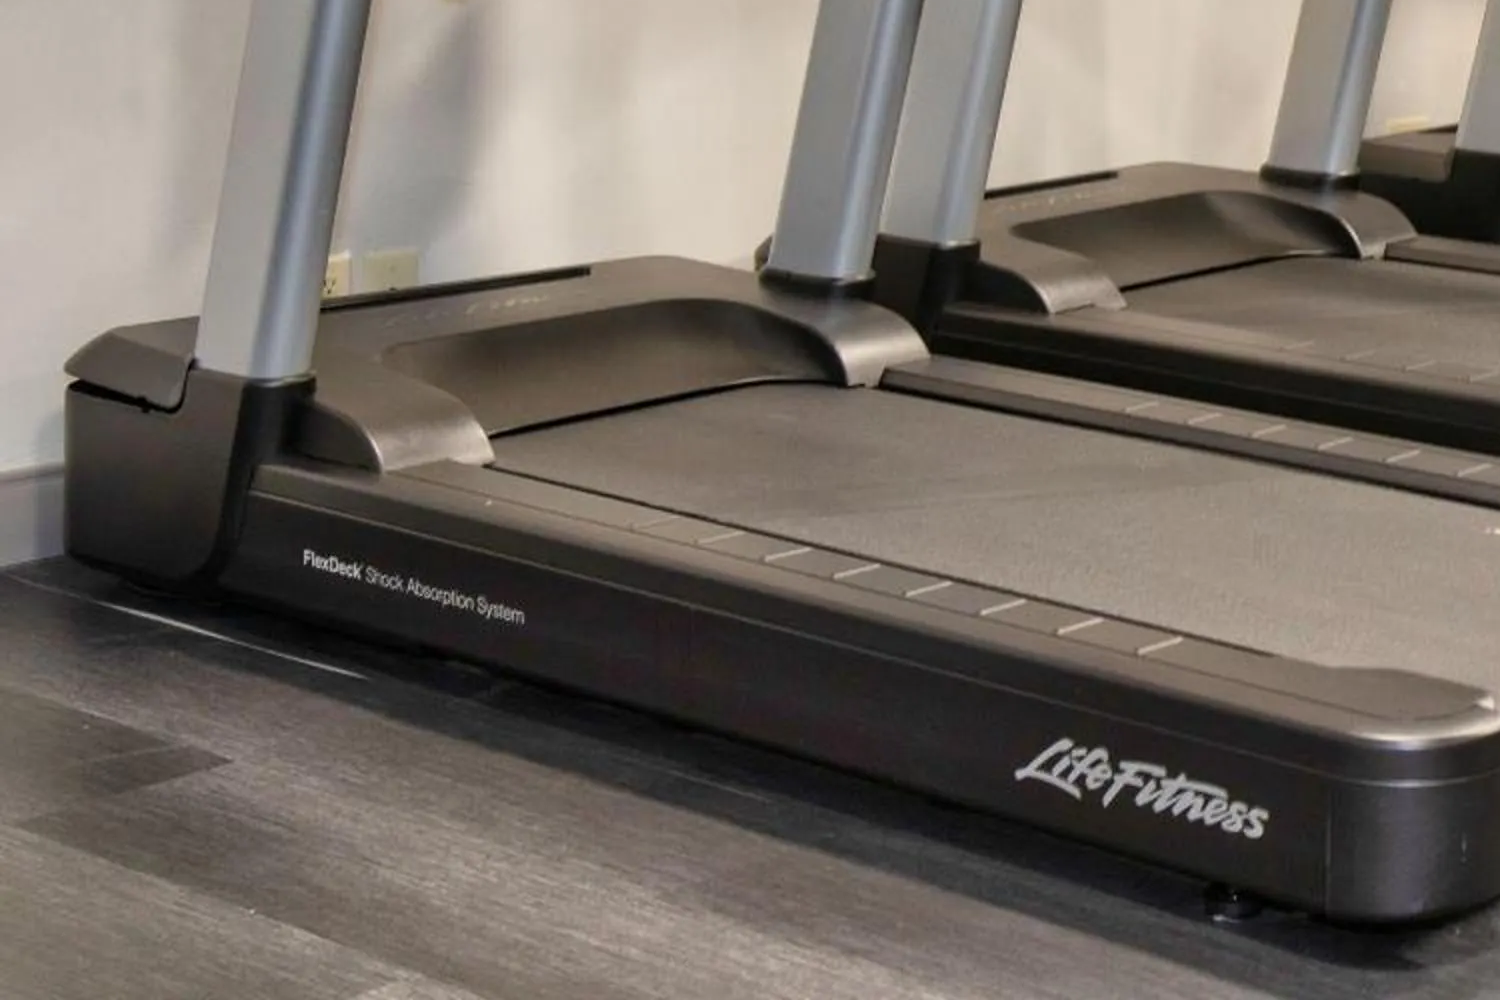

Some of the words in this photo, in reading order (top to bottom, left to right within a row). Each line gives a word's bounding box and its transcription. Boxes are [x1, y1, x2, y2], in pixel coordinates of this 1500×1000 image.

[303, 549, 362, 580] FlexDeck
[364, 565, 404, 591] Shock
[406, 577, 475, 613] Absorption
[476, 596, 525, 625] System
